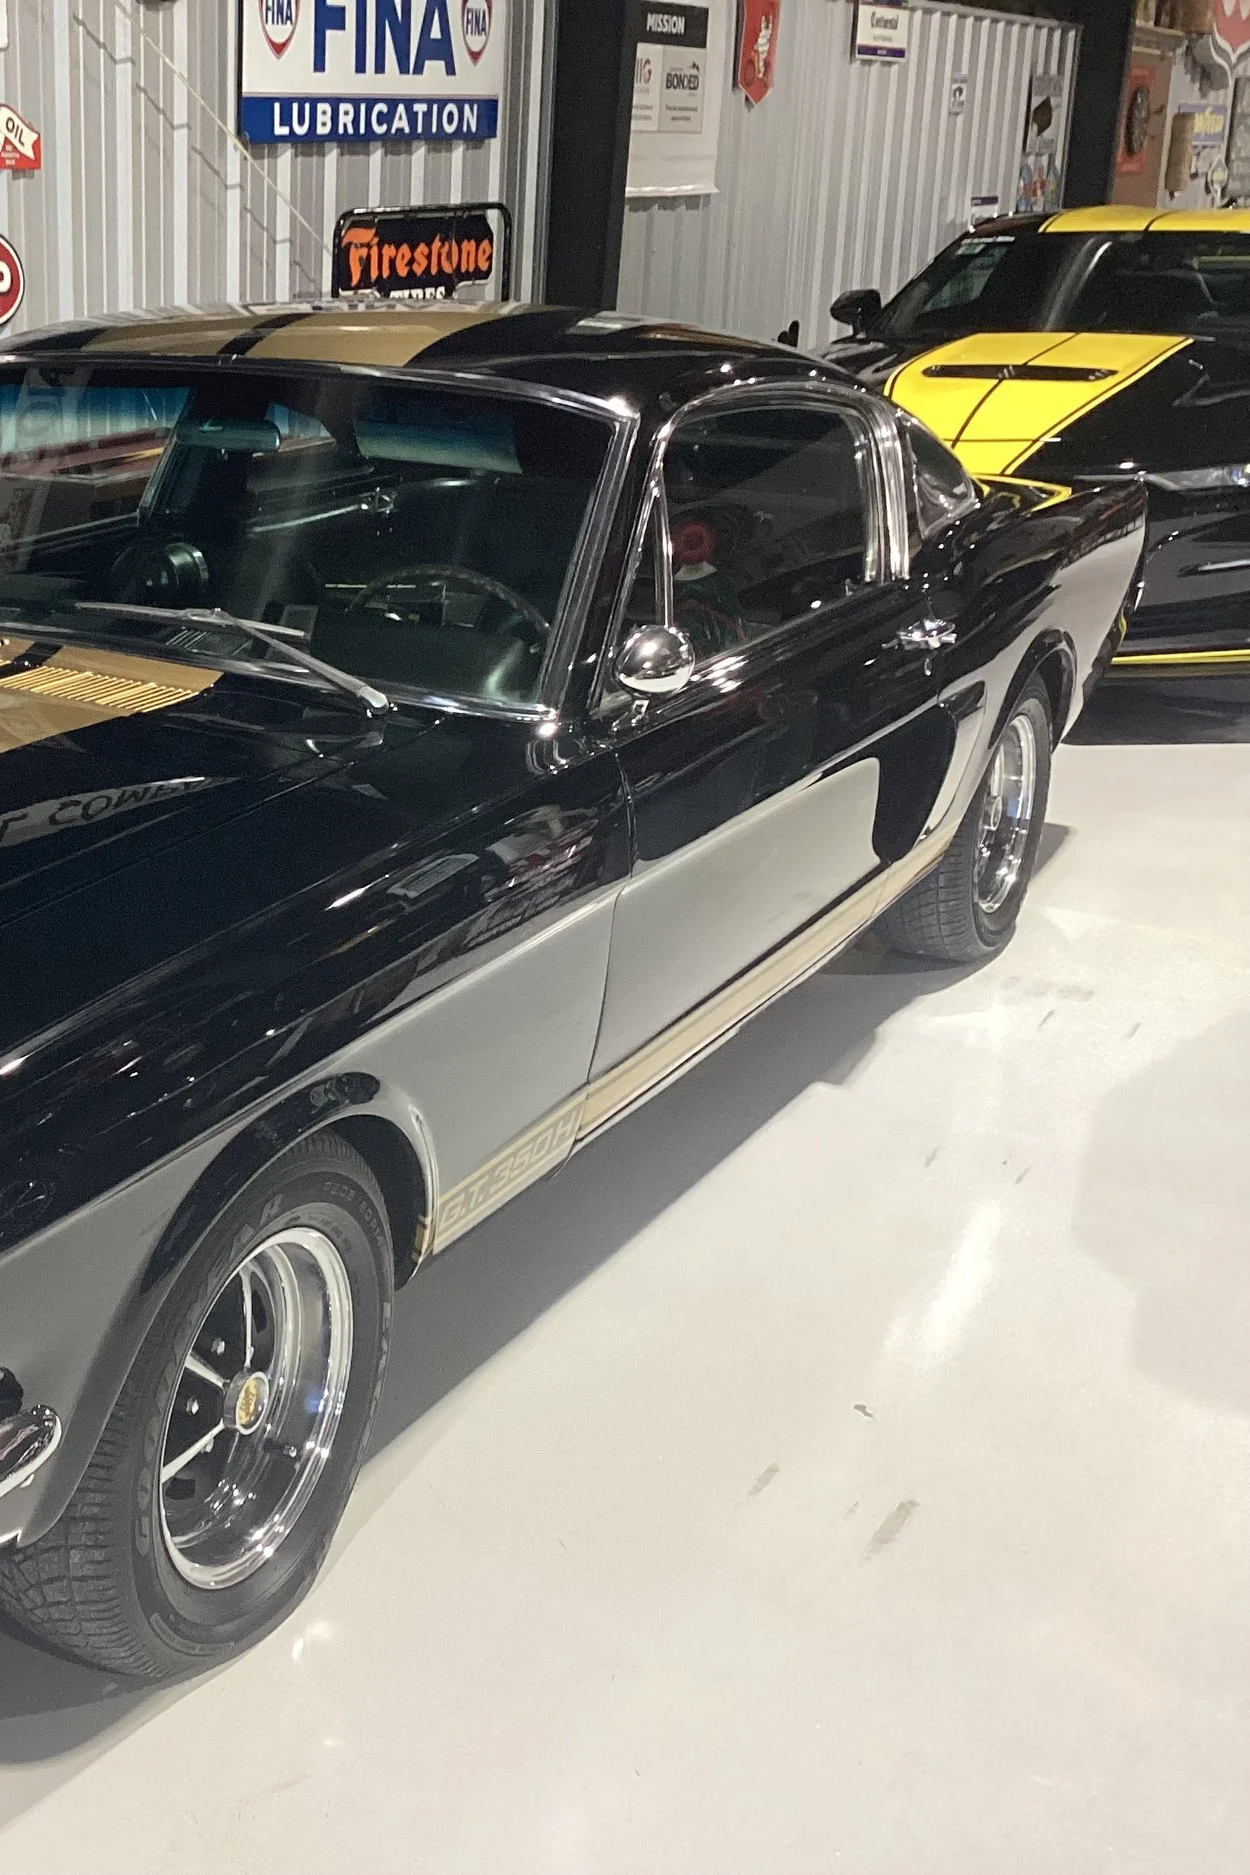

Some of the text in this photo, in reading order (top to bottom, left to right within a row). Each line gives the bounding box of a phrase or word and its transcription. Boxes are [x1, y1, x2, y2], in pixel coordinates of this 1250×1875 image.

[265, 0, 292, 26] FINA
[465, 8, 487, 37] FINA
[646, 12, 686, 35] MISSION
[313, 0, 457, 77] FINA
[665, 72, 700, 91] BONDED
[5, 116, 25, 148] OIL
[273, 102, 478, 137] LUBRICATION
[341, 227, 493, 287] Firestone
